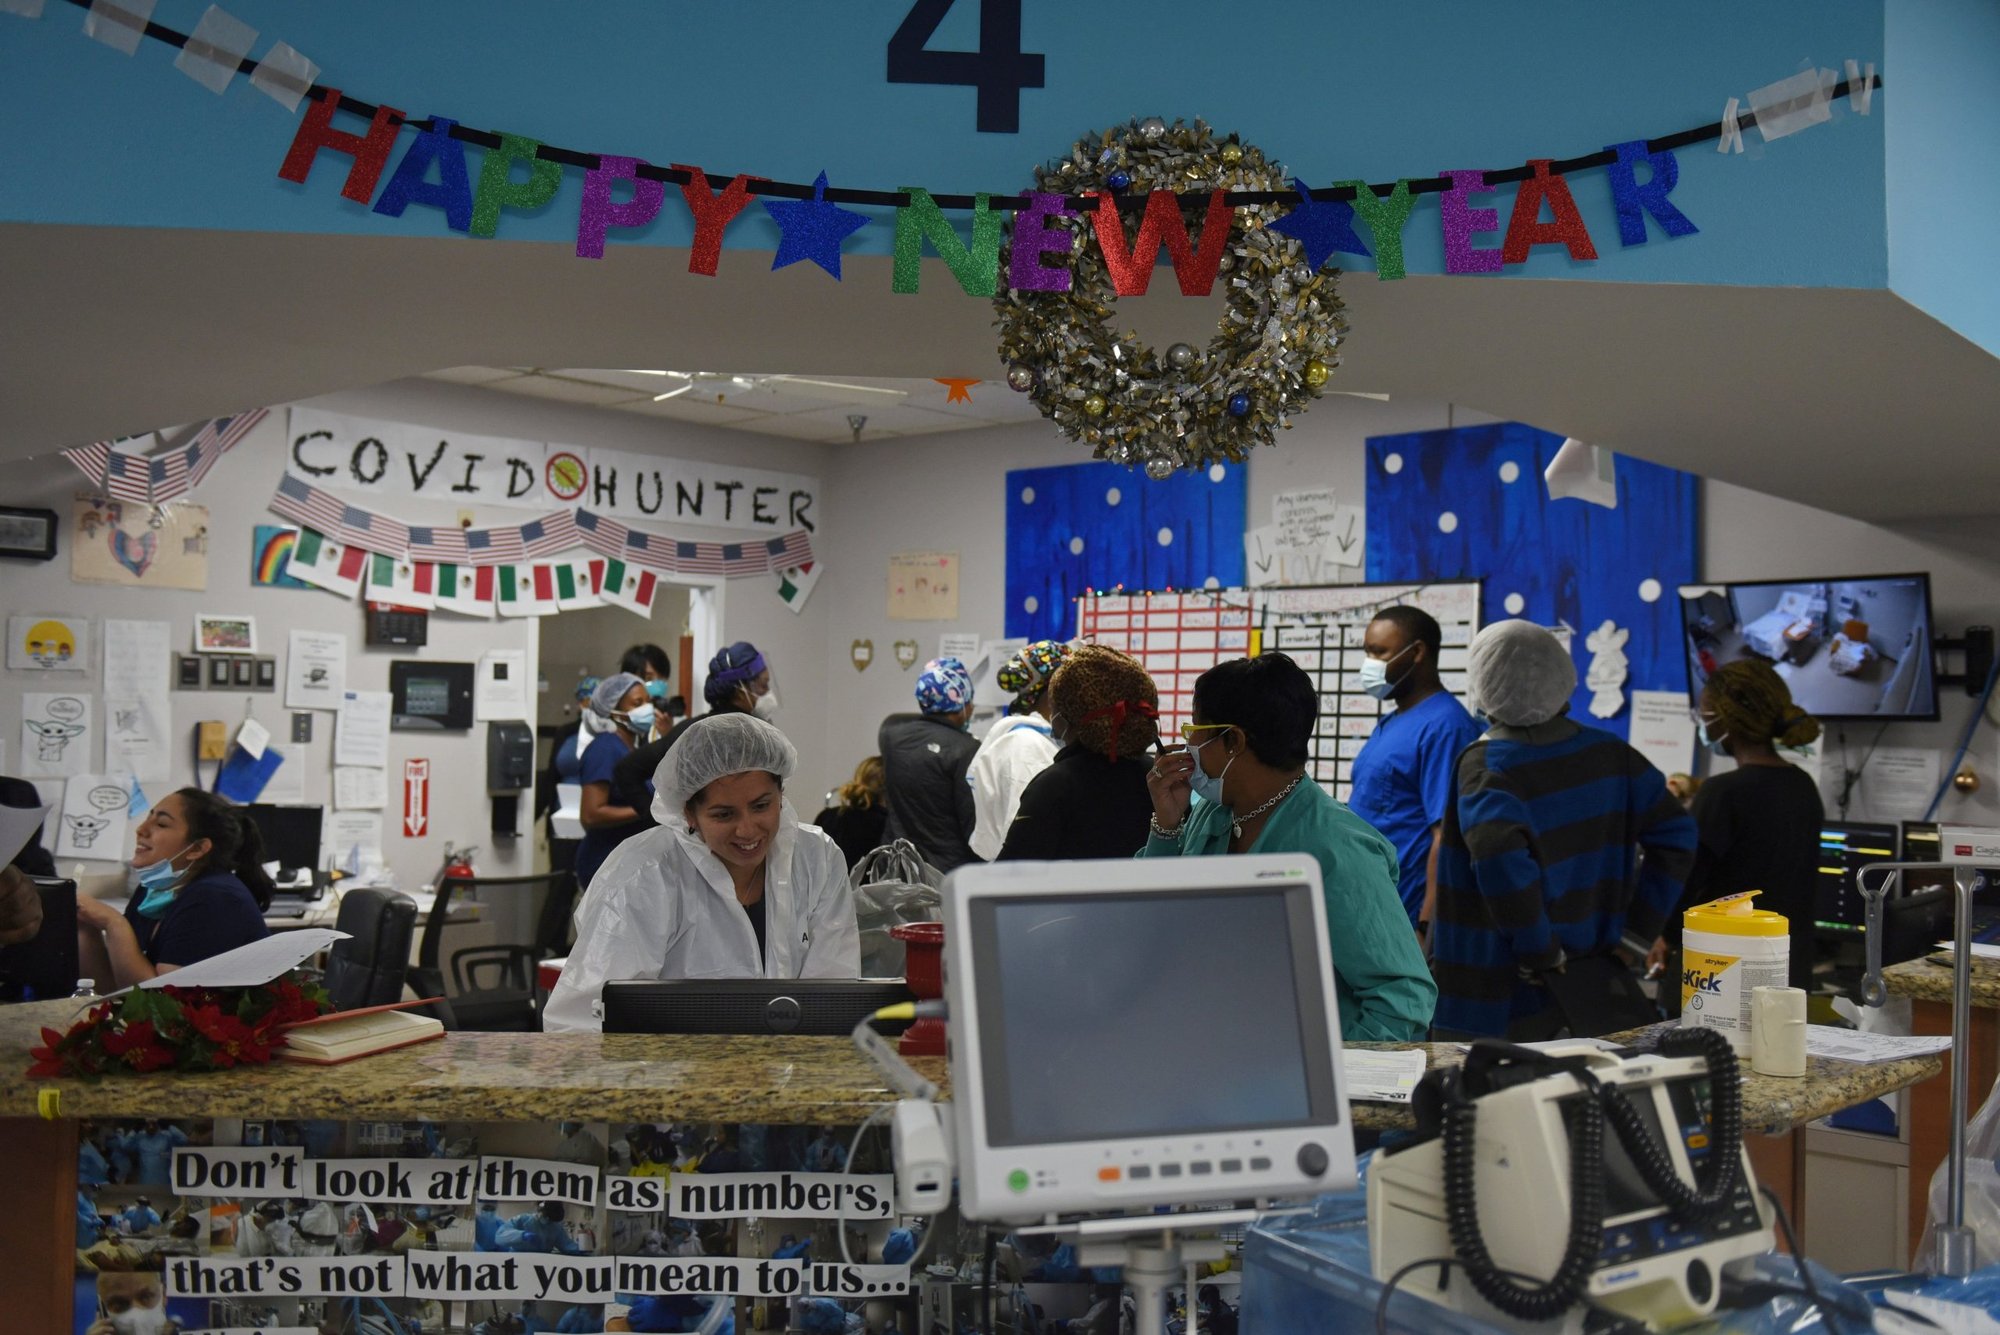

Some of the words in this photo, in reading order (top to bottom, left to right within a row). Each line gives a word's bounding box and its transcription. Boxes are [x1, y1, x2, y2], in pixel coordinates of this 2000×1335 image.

[887, 0, 1045, 133] 4
[277, 85, 772, 277] HAPPY
[892, 185, 1231, 298] NEW
[1332, 139, 1700, 281] YEAR
[292, 430, 536, 499] COVID
[593, 464, 816, 533] HUNTER
[408, 765, 424, 777] FIRE
[176, 1152, 298, 1190] Don't
[315, 1161, 412, 1198] look
[427, 1164, 471, 1200] at
[483, 1160, 594, 1203] them
[609, 1178, 660, 1208] as
[680, 1174, 891, 1217] numbers,
[171, 1258, 303, 1294] that's
[319, 1259, 393, 1294] not
[411, 1255, 519, 1292] what
[533, 1264, 613, 1299] you
[619, 1262, 740, 1293] mean
[756, 1260, 800, 1294] to
[812, 1264, 907, 1294] us...
